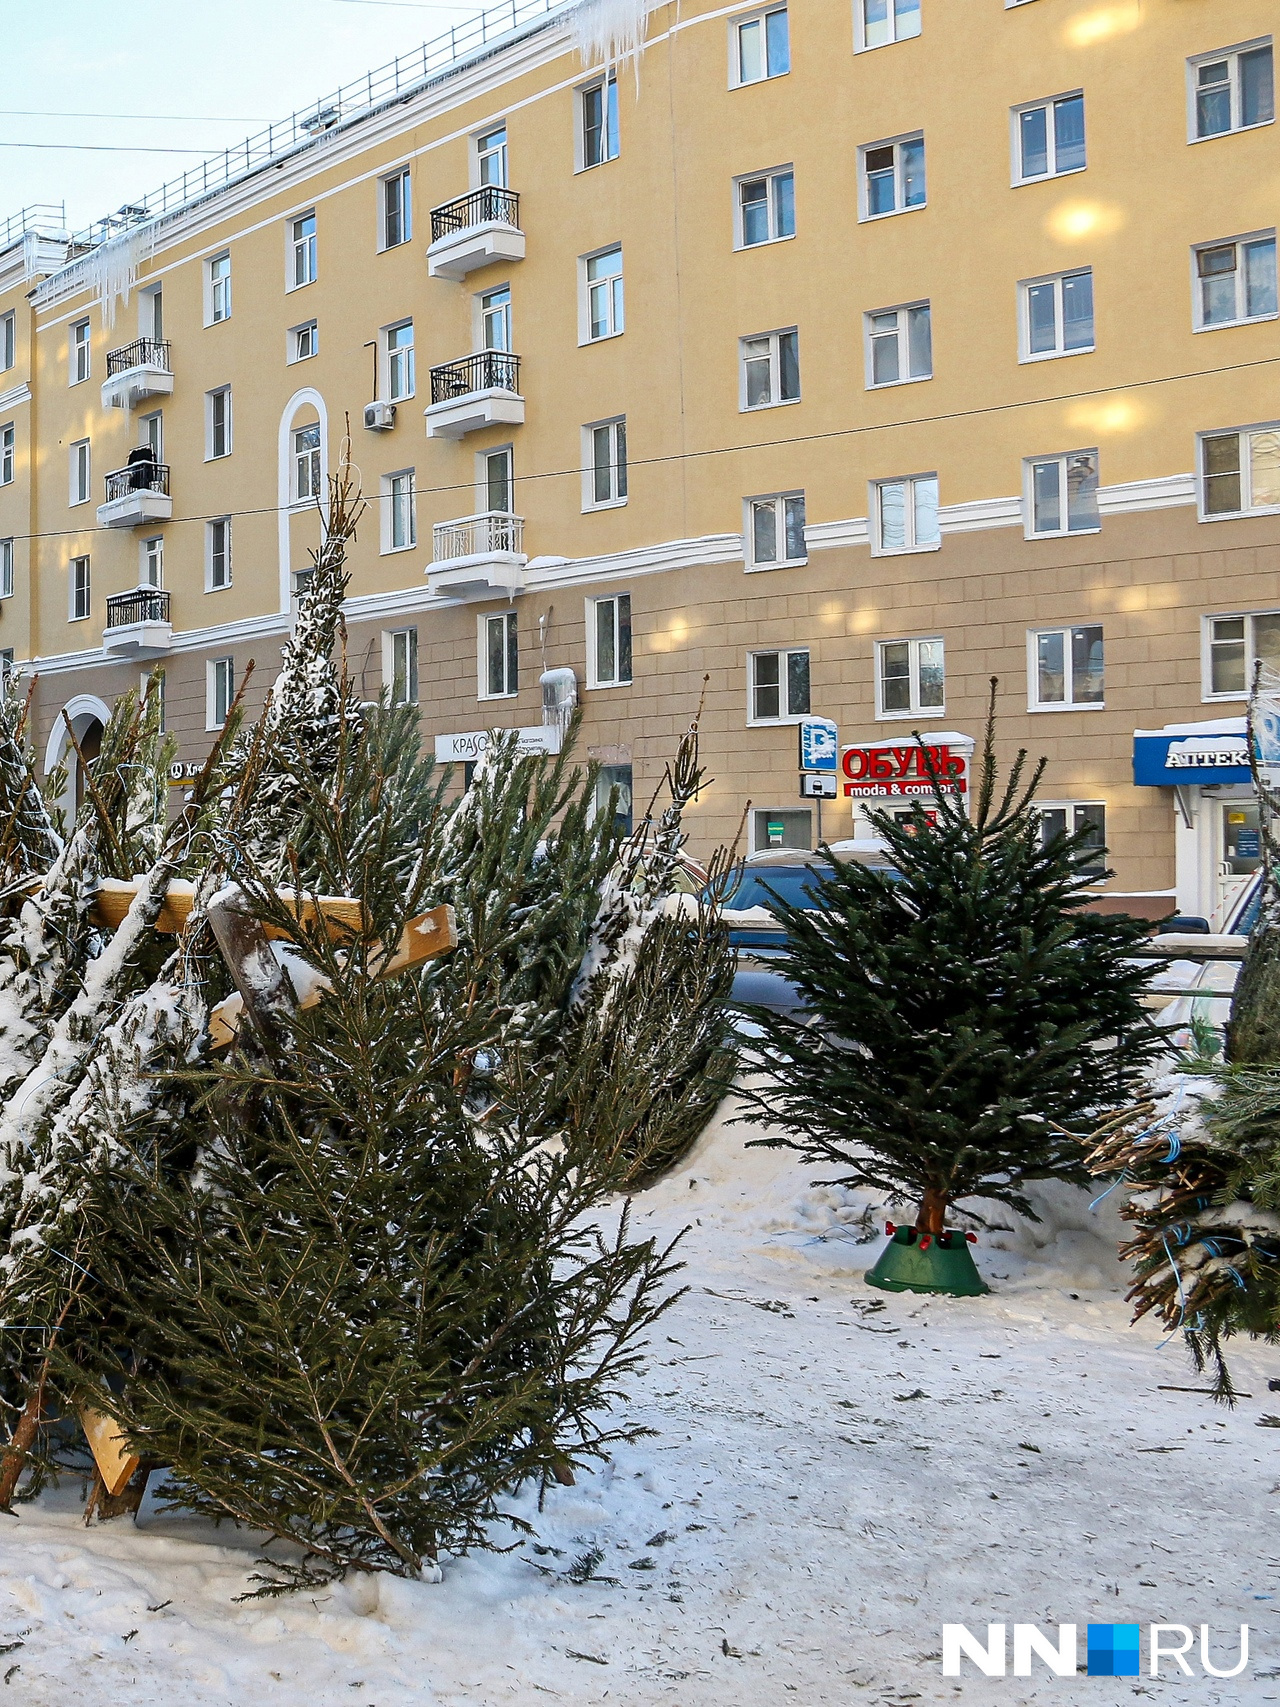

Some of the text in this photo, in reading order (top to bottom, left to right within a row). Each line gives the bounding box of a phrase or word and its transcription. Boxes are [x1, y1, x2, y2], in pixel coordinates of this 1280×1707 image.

[842, 744, 966, 780] ОБУВЬ
[1164, 750, 1252, 768] АПТЕК
[850, 782, 957, 796] moda & comor
